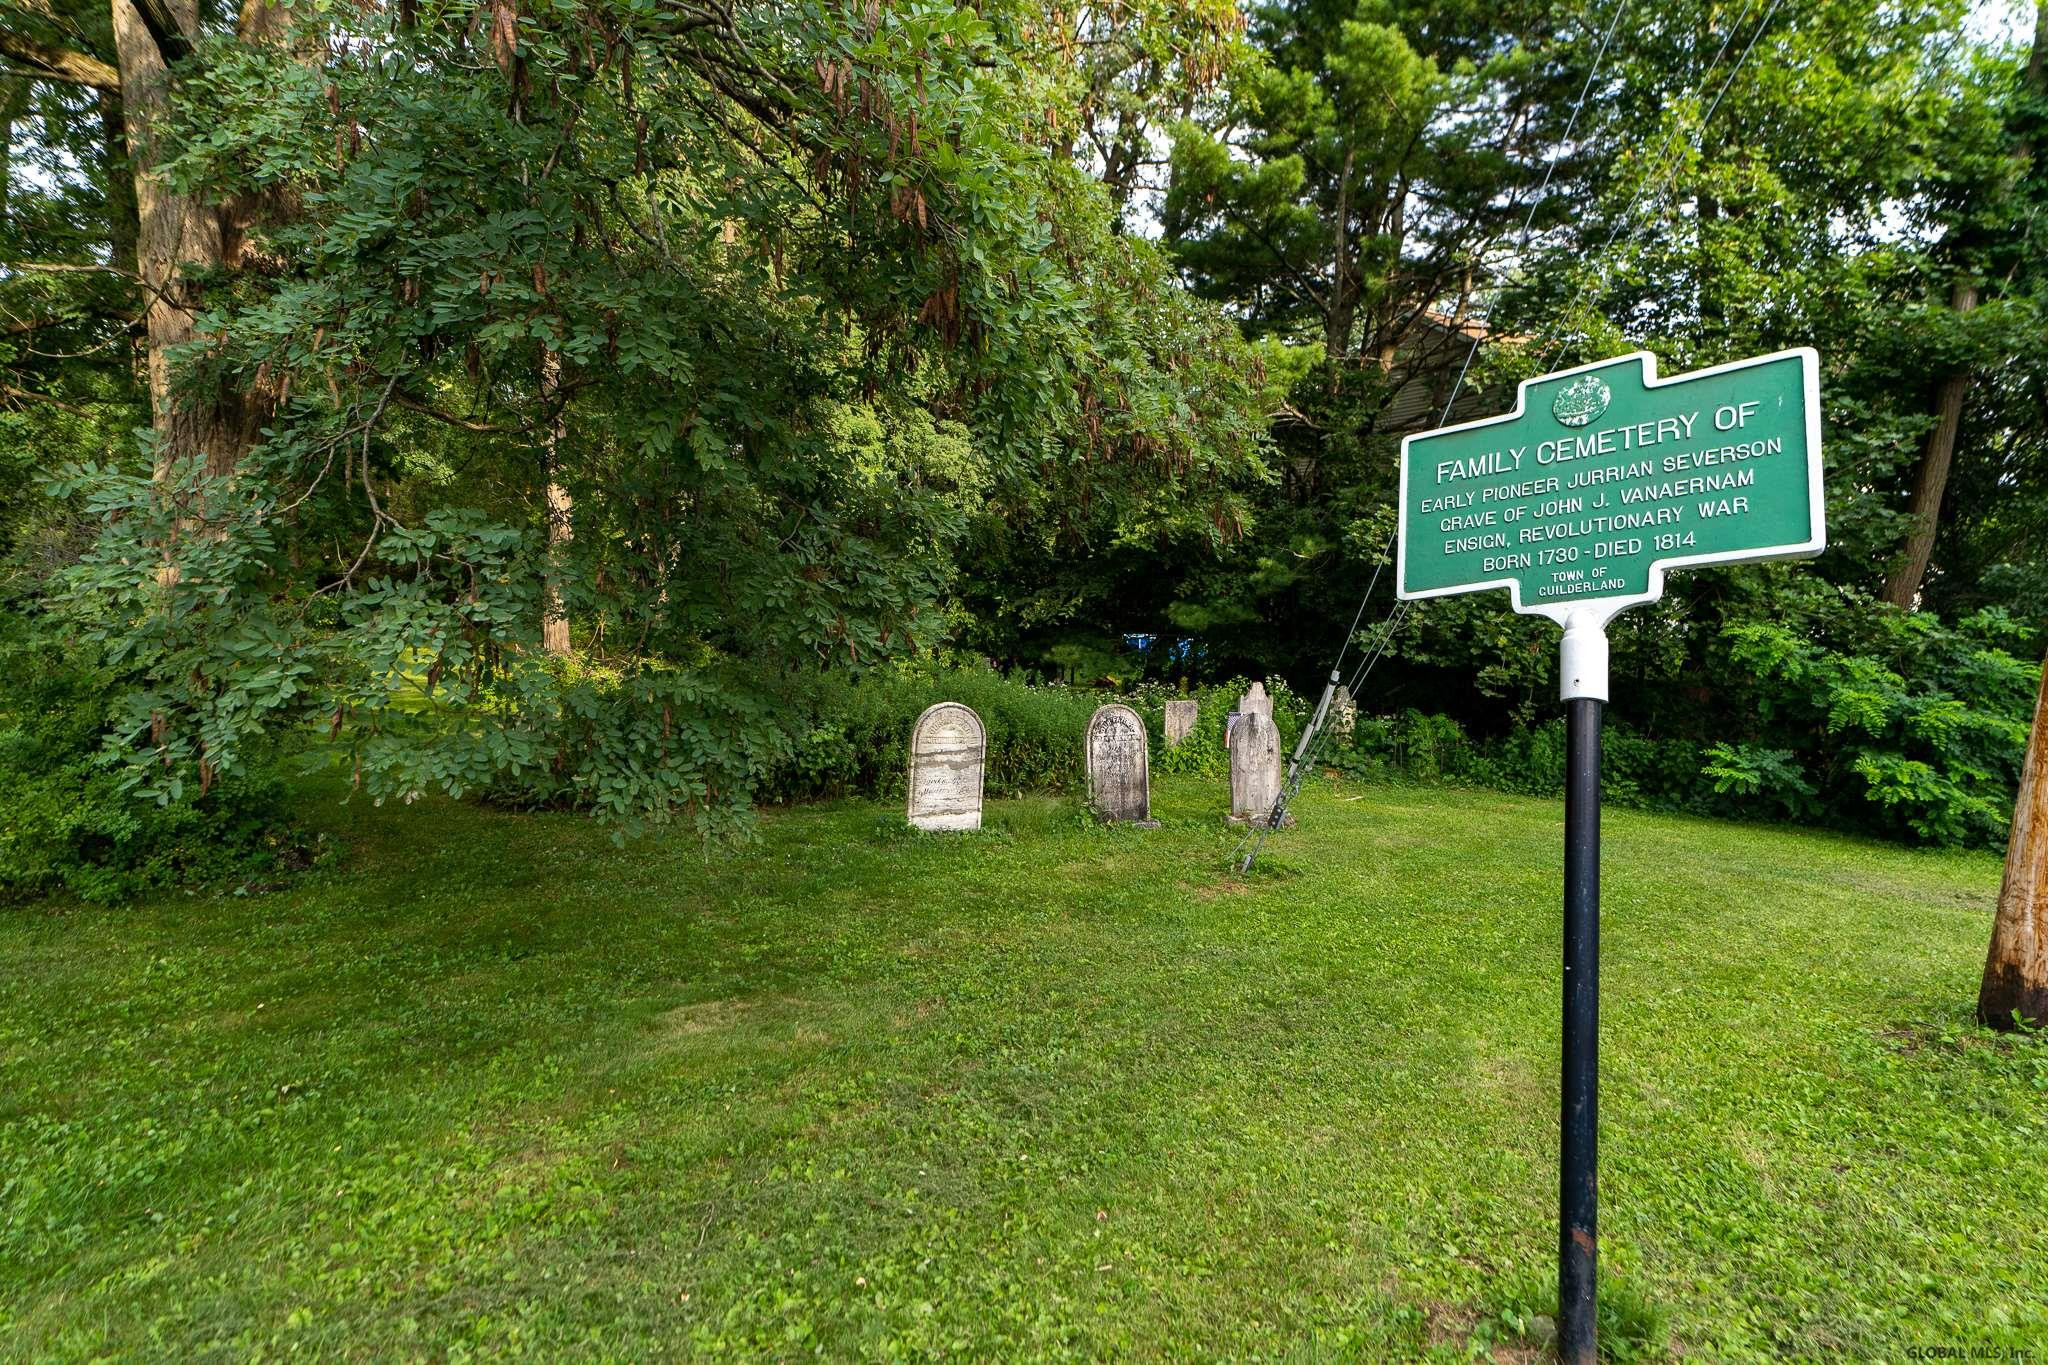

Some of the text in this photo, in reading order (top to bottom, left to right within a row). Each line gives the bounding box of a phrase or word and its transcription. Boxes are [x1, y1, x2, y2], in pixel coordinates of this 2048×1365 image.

[1437, 401, 1760, 484] FAMILY CEMETERY OF
[1421, 437, 1782, 513] EARLY PIONEER JURRIAN SEVERSON
[1440, 469, 1754, 532] GRAVE OF JOHN J. VANAERNAM
[1445, 497, 1748, 554] ENSIGN, REVOLUTIONARY WAR
[1483, 552, 1531, 572] BORN
[1538, 546, 1578, 565] 1730
[1653, 531, 1696, 552] 1814
[1538, 578, 1625, 597] GUILDERLAND
[1551, 567, 1607, 583] TOWN OF
